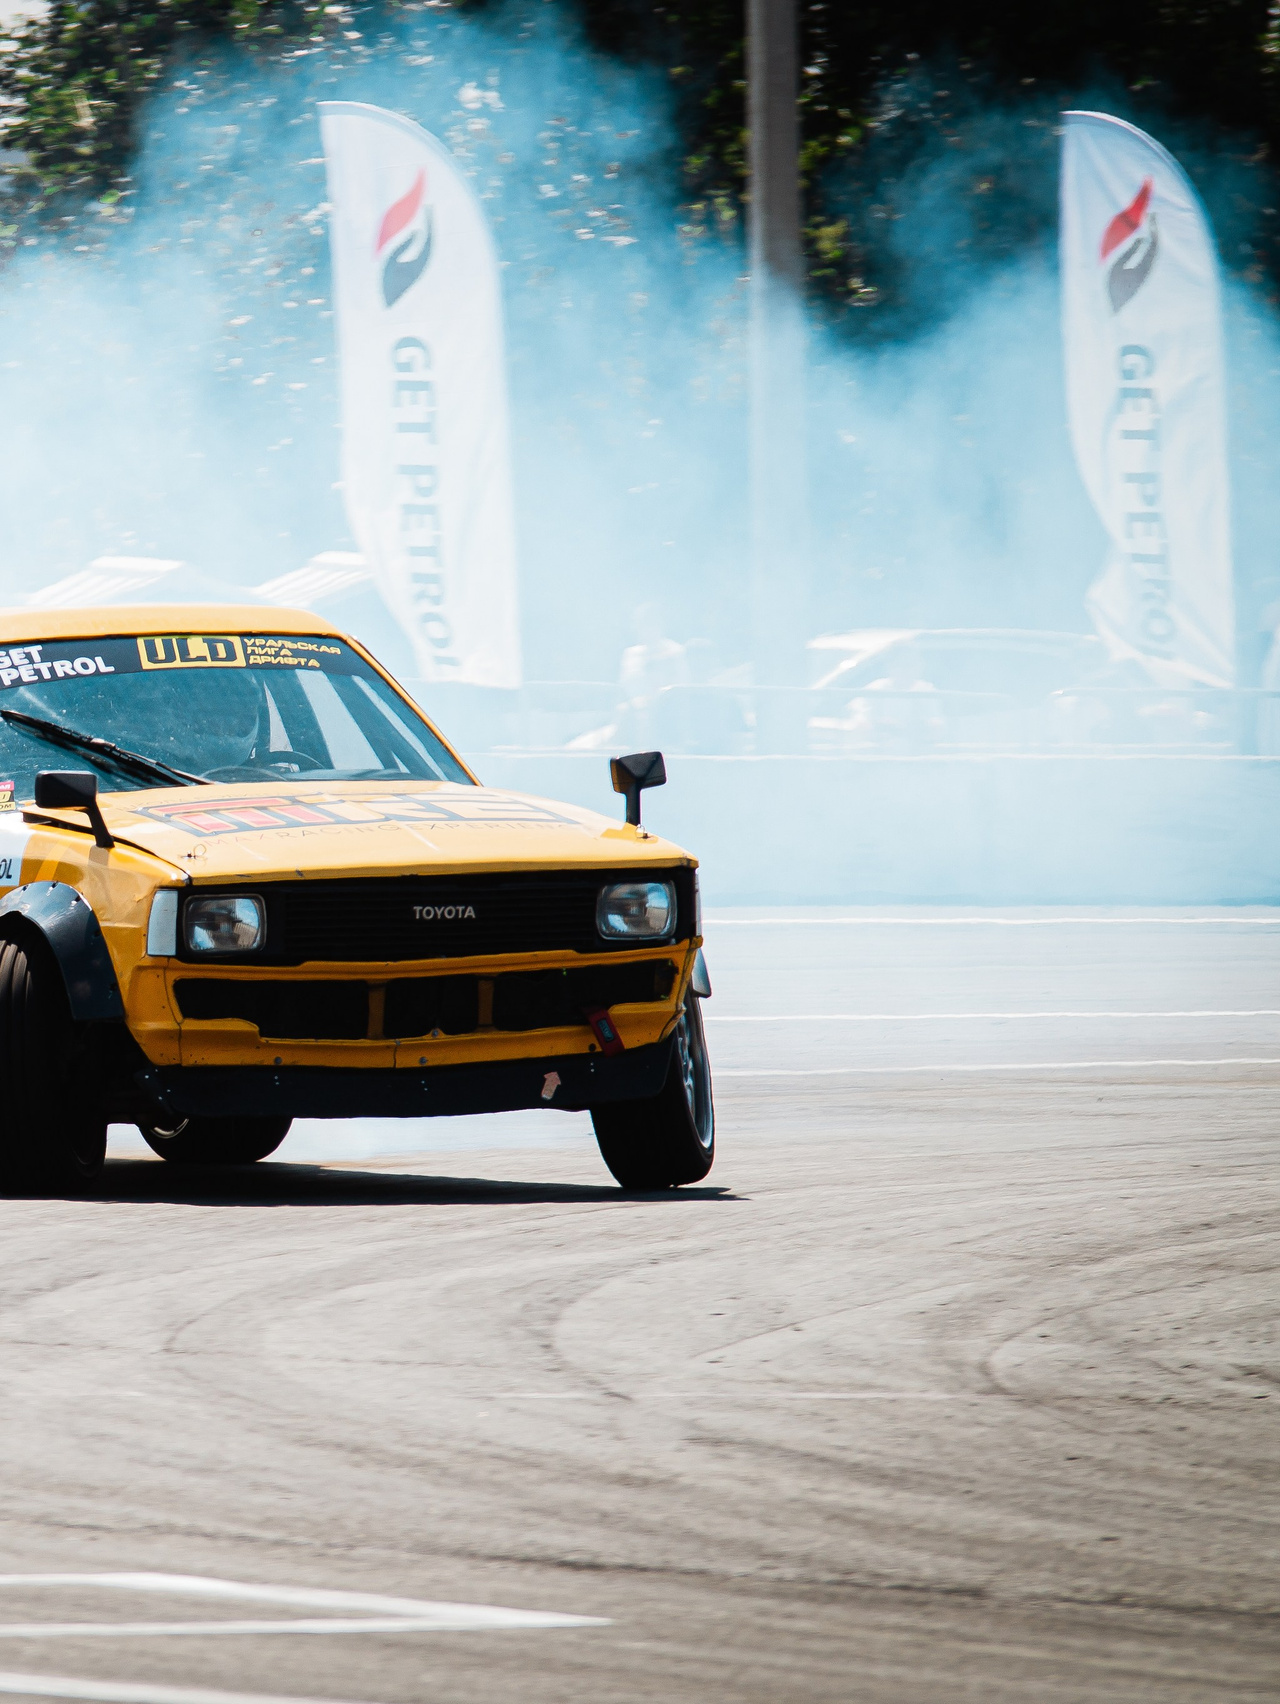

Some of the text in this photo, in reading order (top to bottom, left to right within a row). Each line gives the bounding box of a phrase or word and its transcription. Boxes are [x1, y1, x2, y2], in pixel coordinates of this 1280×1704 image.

[390, 336, 440, 445] GET
[1117, 343, 1162, 452] GET
[143, 637, 239, 665] ULD
[243, 638, 342, 655] УРАЛЬСКАЯ
[247, 646, 293, 657] ЛИГА
[0, 656, 115, 686] PETROL
[249, 655, 321, 668] ДРИФТА
[413, 906, 476, 919] TOYOTA
